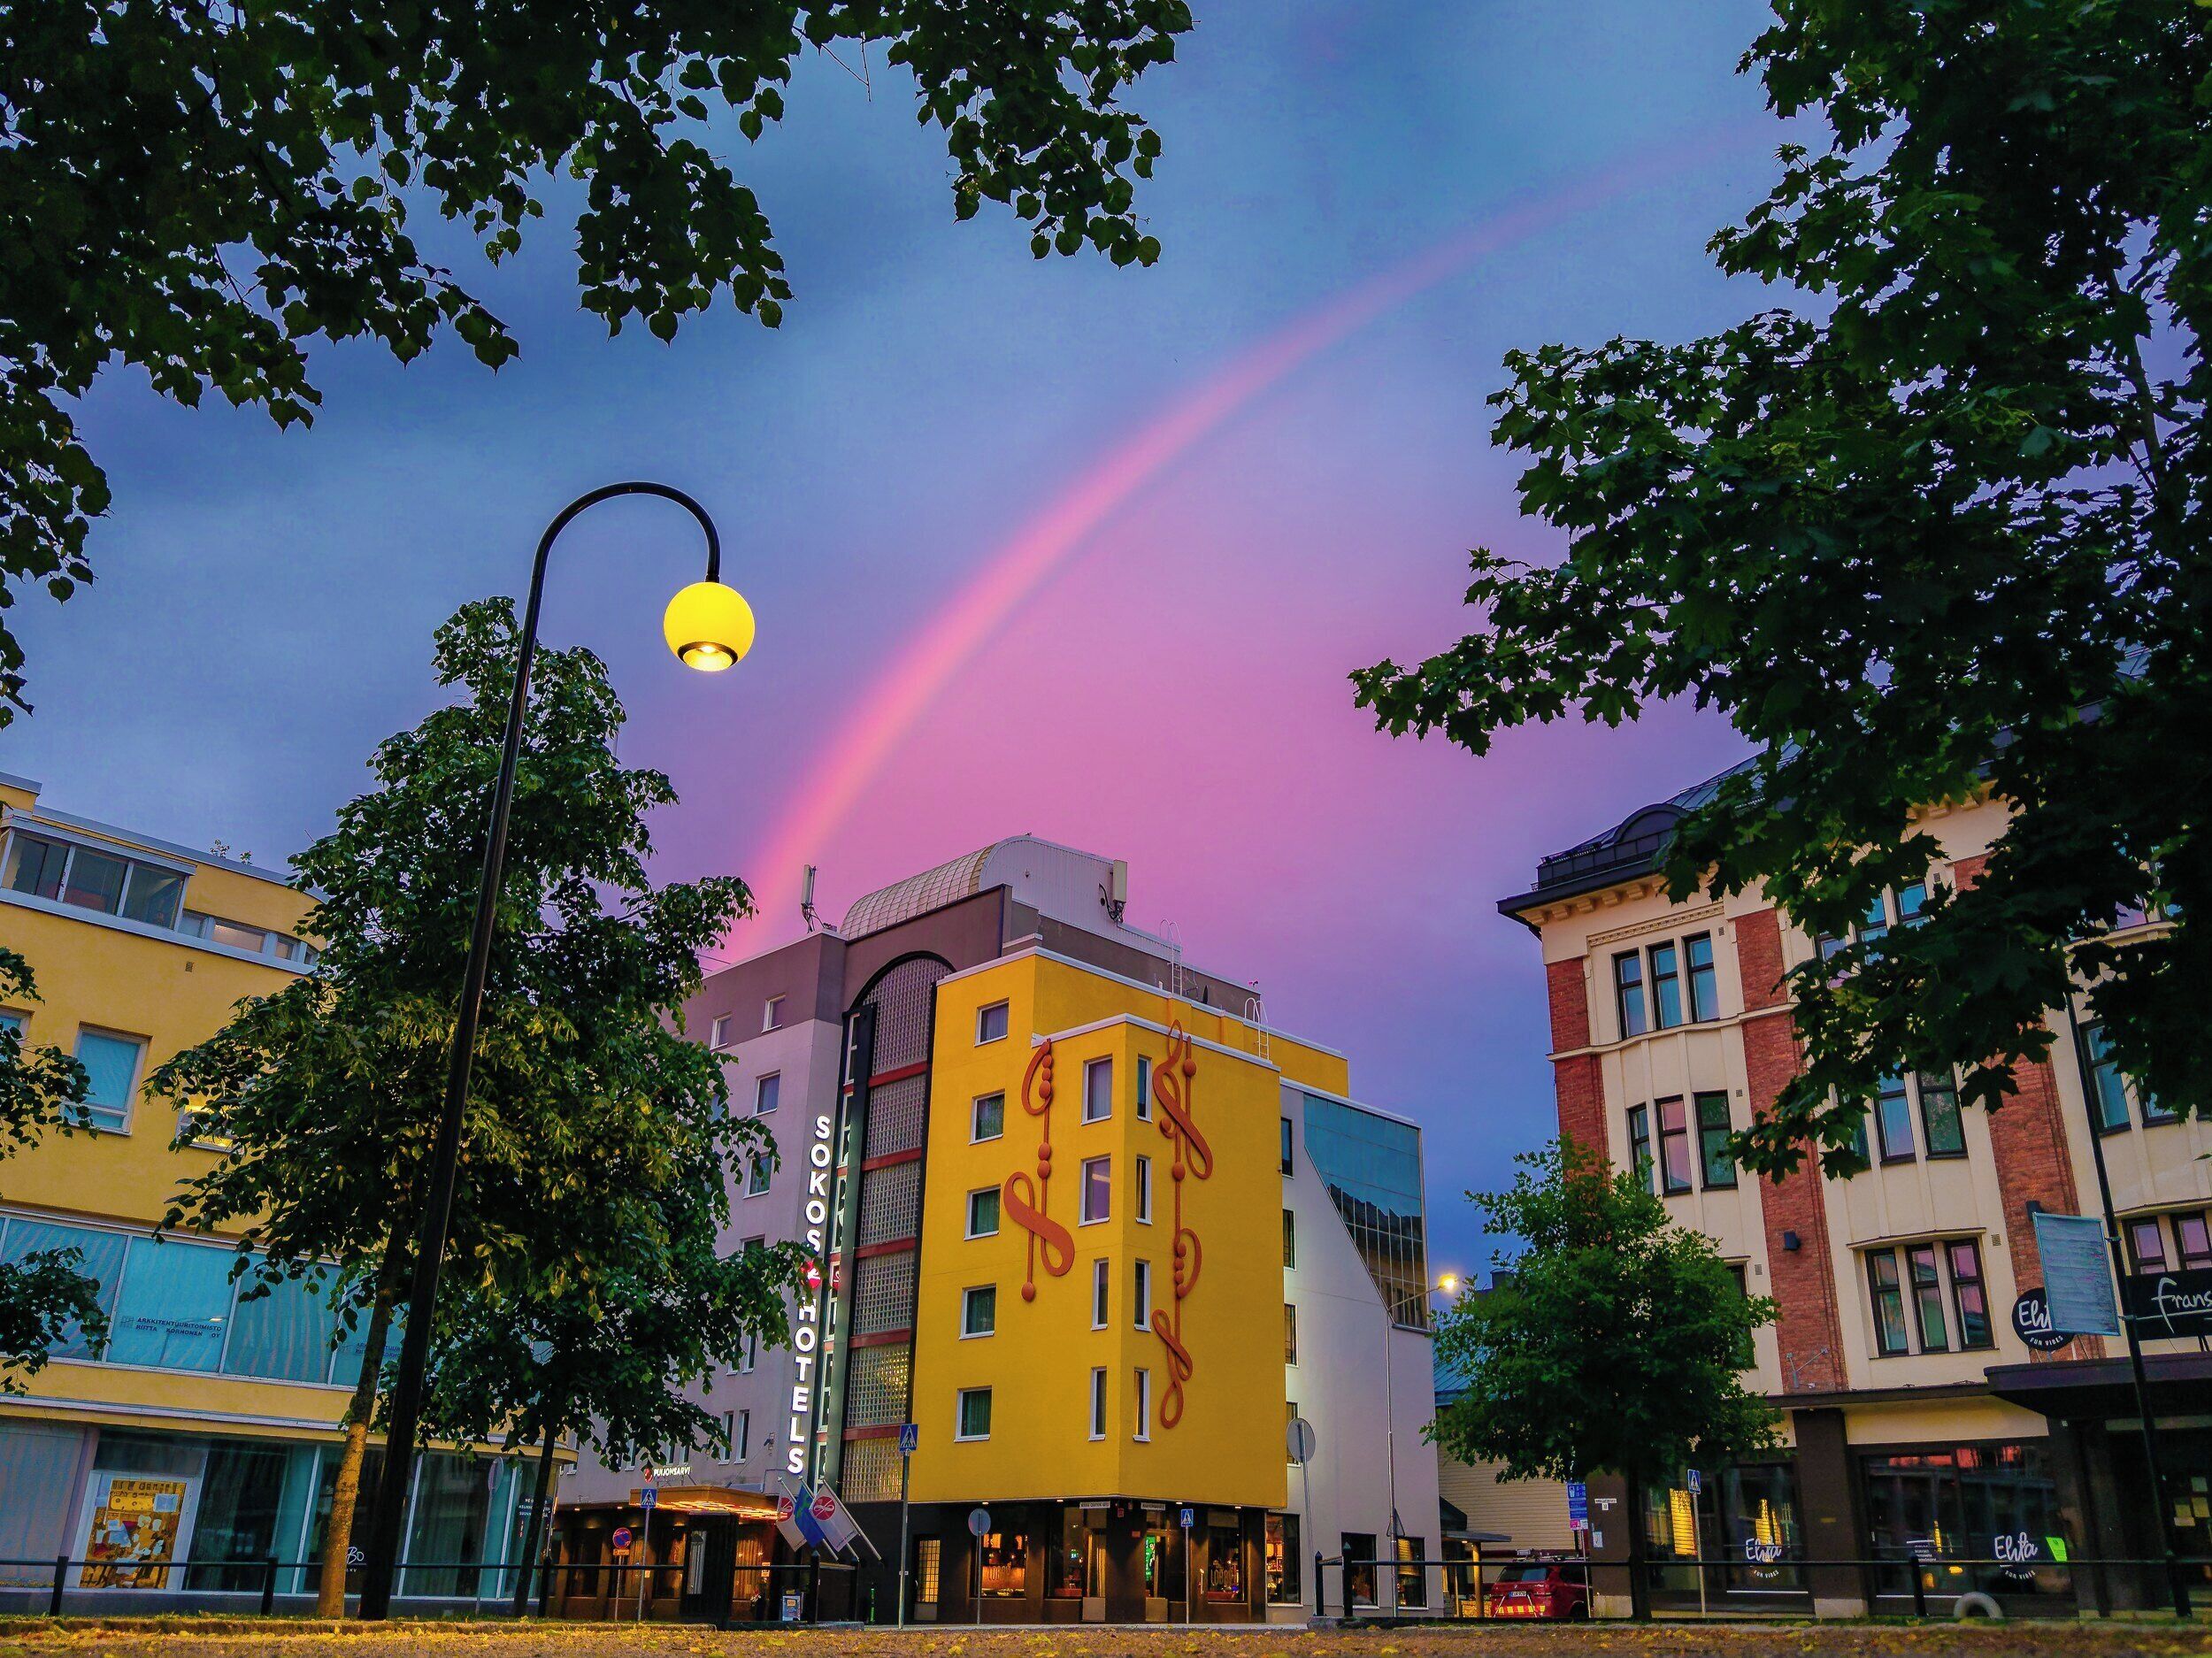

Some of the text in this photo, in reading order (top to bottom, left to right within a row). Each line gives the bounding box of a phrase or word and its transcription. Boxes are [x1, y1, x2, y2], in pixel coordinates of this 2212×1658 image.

[805, 1116, 831, 1252] SOKOS
[137, 1316, 222, 1332] ARKKITEHTUURITOIMISTO
[165, 1328, 204, 1337] KORHONEN
[2030, 1335, 2063, 1346] FUN VIBES
[787, 1296, 817, 1474] HOTELS
